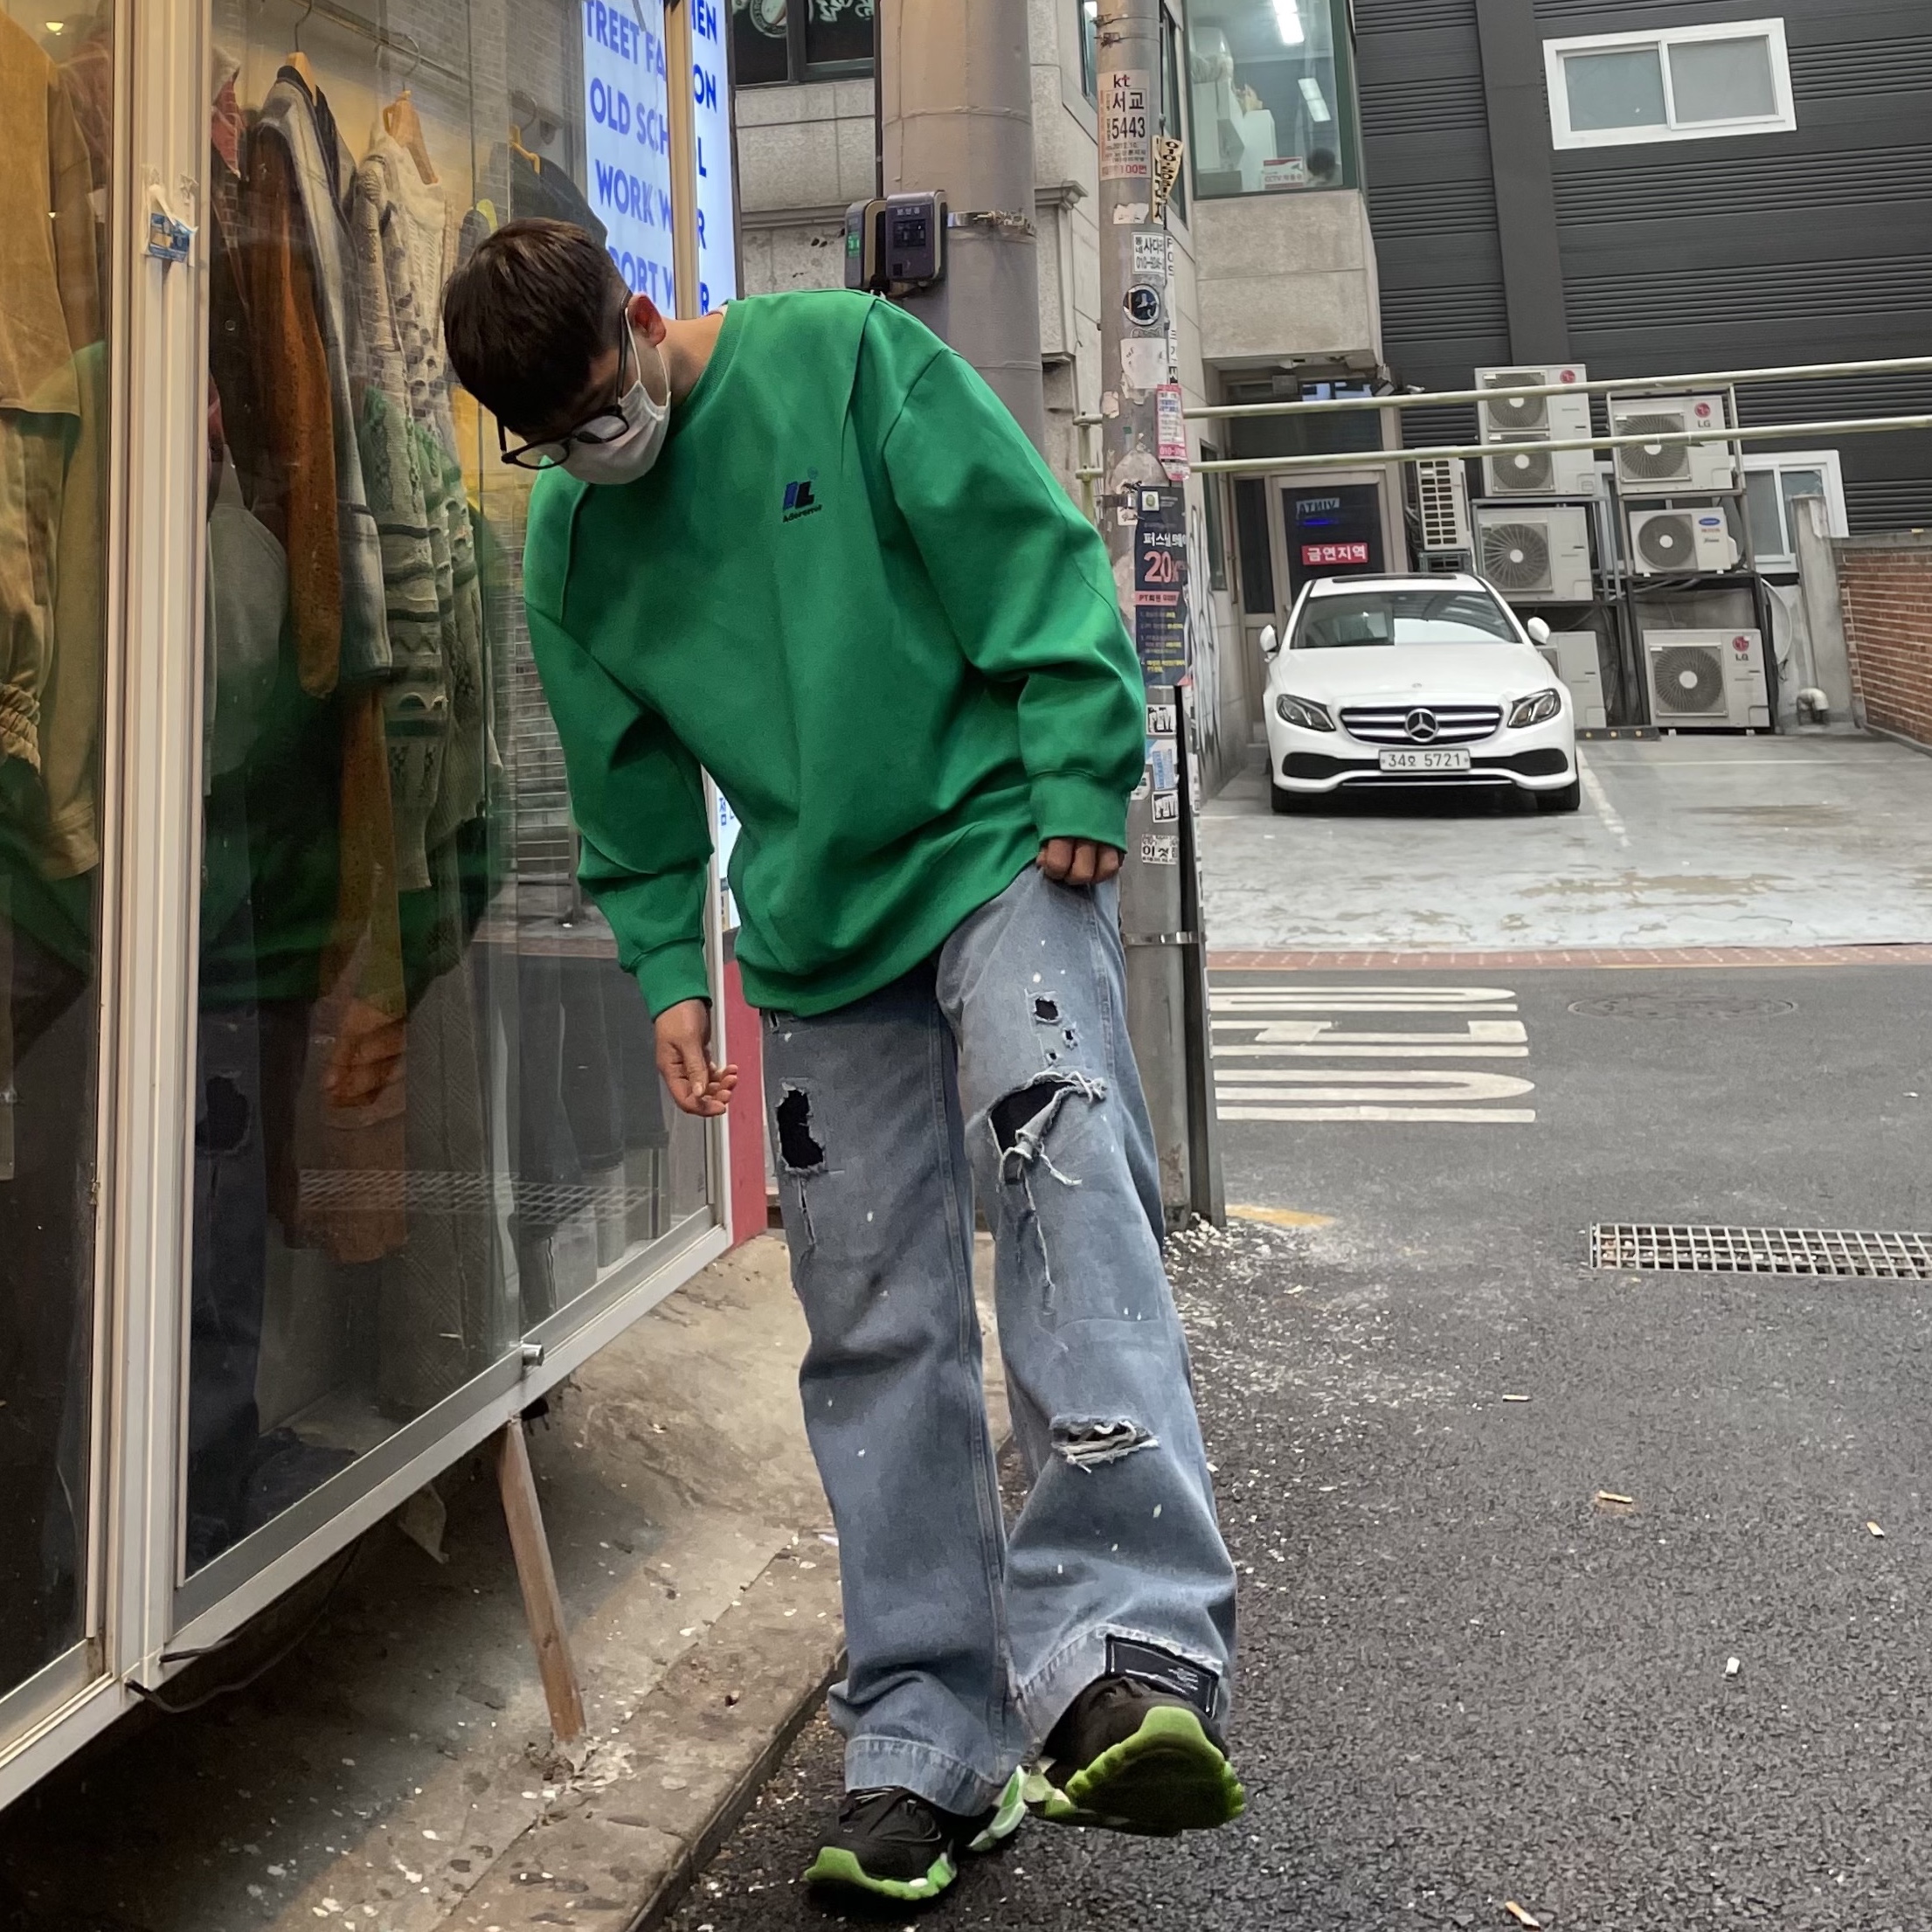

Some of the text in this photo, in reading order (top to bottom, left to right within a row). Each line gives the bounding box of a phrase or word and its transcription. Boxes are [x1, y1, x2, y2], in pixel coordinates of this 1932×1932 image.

[586, 0, 640, 65] TREET
[1114, 74, 1131, 88] kt
[590, 77, 631, 135] OLD
[1112, 91, 1145, 113] 서교
[1111, 116, 1146, 139] 5443
[595, 159, 654, 227] WORK
[1307, 544, 1367, 562] 금연지역
[1424, 753, 1460, 767] 5721
